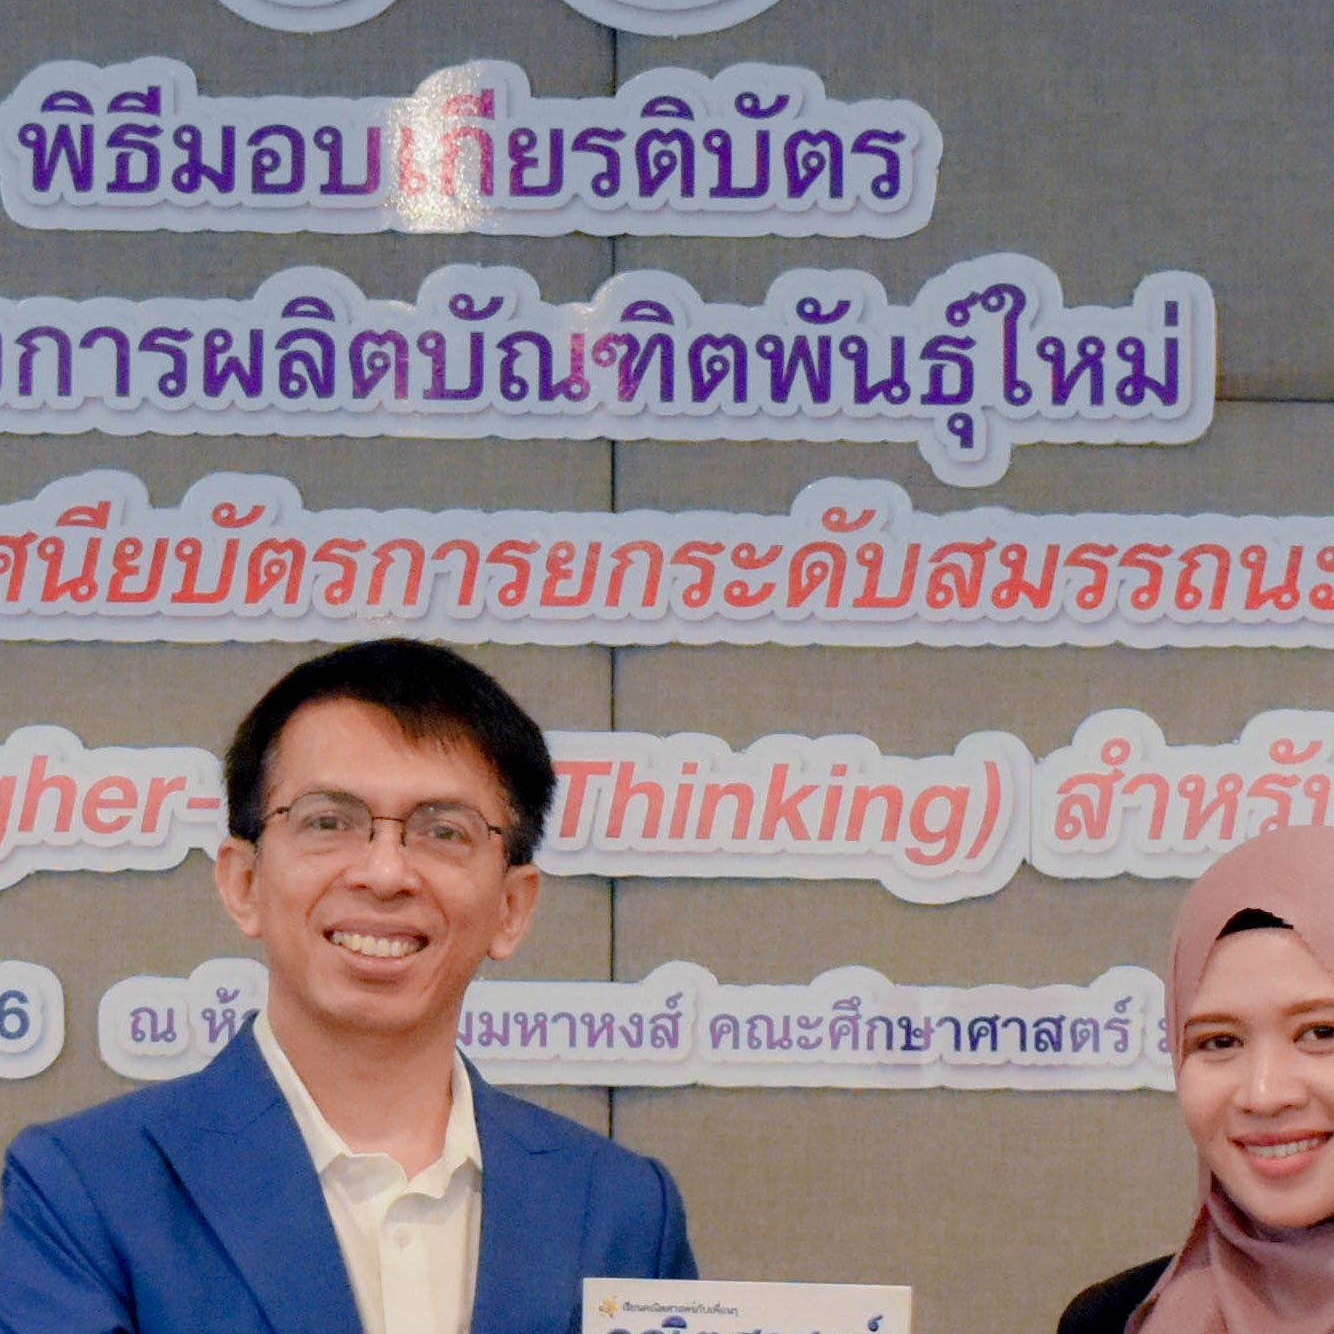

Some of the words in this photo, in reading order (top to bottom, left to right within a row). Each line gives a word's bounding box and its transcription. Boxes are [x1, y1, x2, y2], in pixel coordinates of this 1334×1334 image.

[18, 86, 905, 199] พิธีมอบเกียรติบัตร
[555, 760, 1002, 866] Thinking)
[129, 1005, 178, 1044] ณ
[201, 986, 259, 1044] ห้
[708, 991, 1133, 1054] คณะศึกษาศาสตร์
